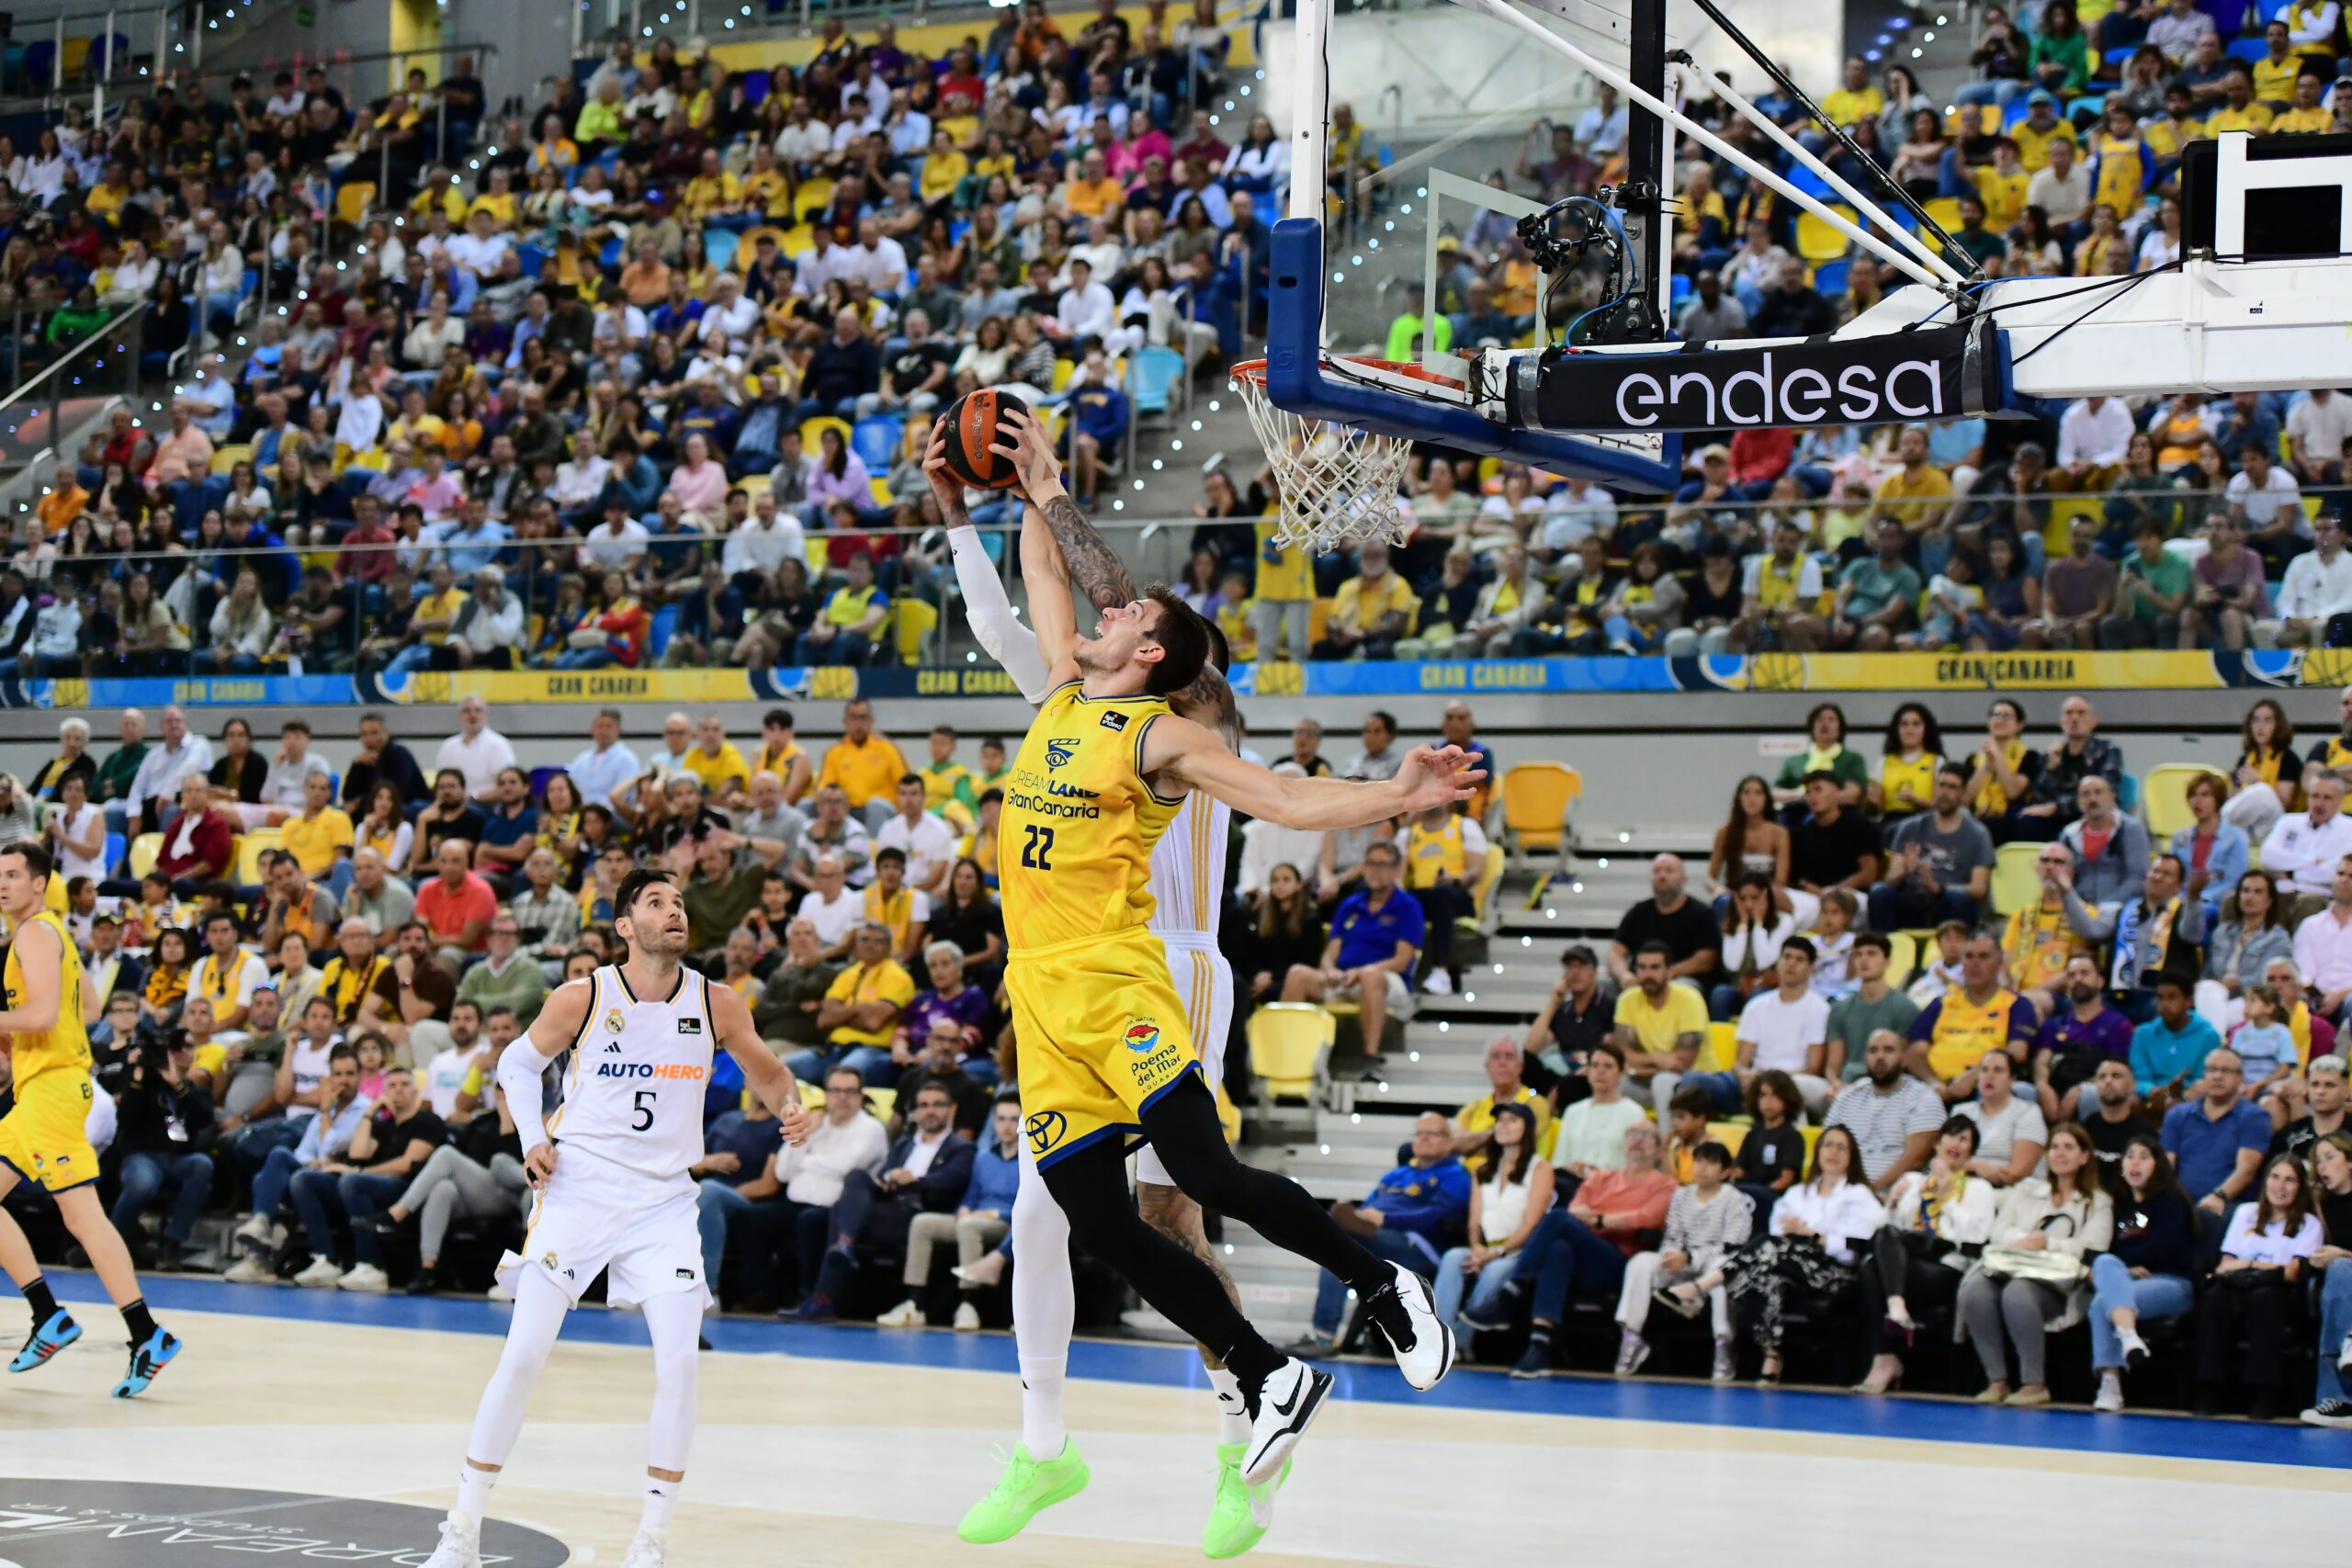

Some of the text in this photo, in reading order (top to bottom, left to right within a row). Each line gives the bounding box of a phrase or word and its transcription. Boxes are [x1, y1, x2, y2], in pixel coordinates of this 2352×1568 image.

[1616, 352, 1943, 426] endesa
[917, 671, 958, 694] GRAN
[1420, 663, 1546, 687] GRAN CANARIA
[1938, 660, 2075, 681] GRAN CANARIA
[548, 676, 648, 695] GRAN CANARIA
[1022, 824, 1054, 871] 22
[597, 1063, 704, 1080] AUTOHERO
[1131, 1044, 1177, 1077] Poema
[1137, 1054, 1182, 1087] del Mar
[631, 1090, 657, 1132] 5
